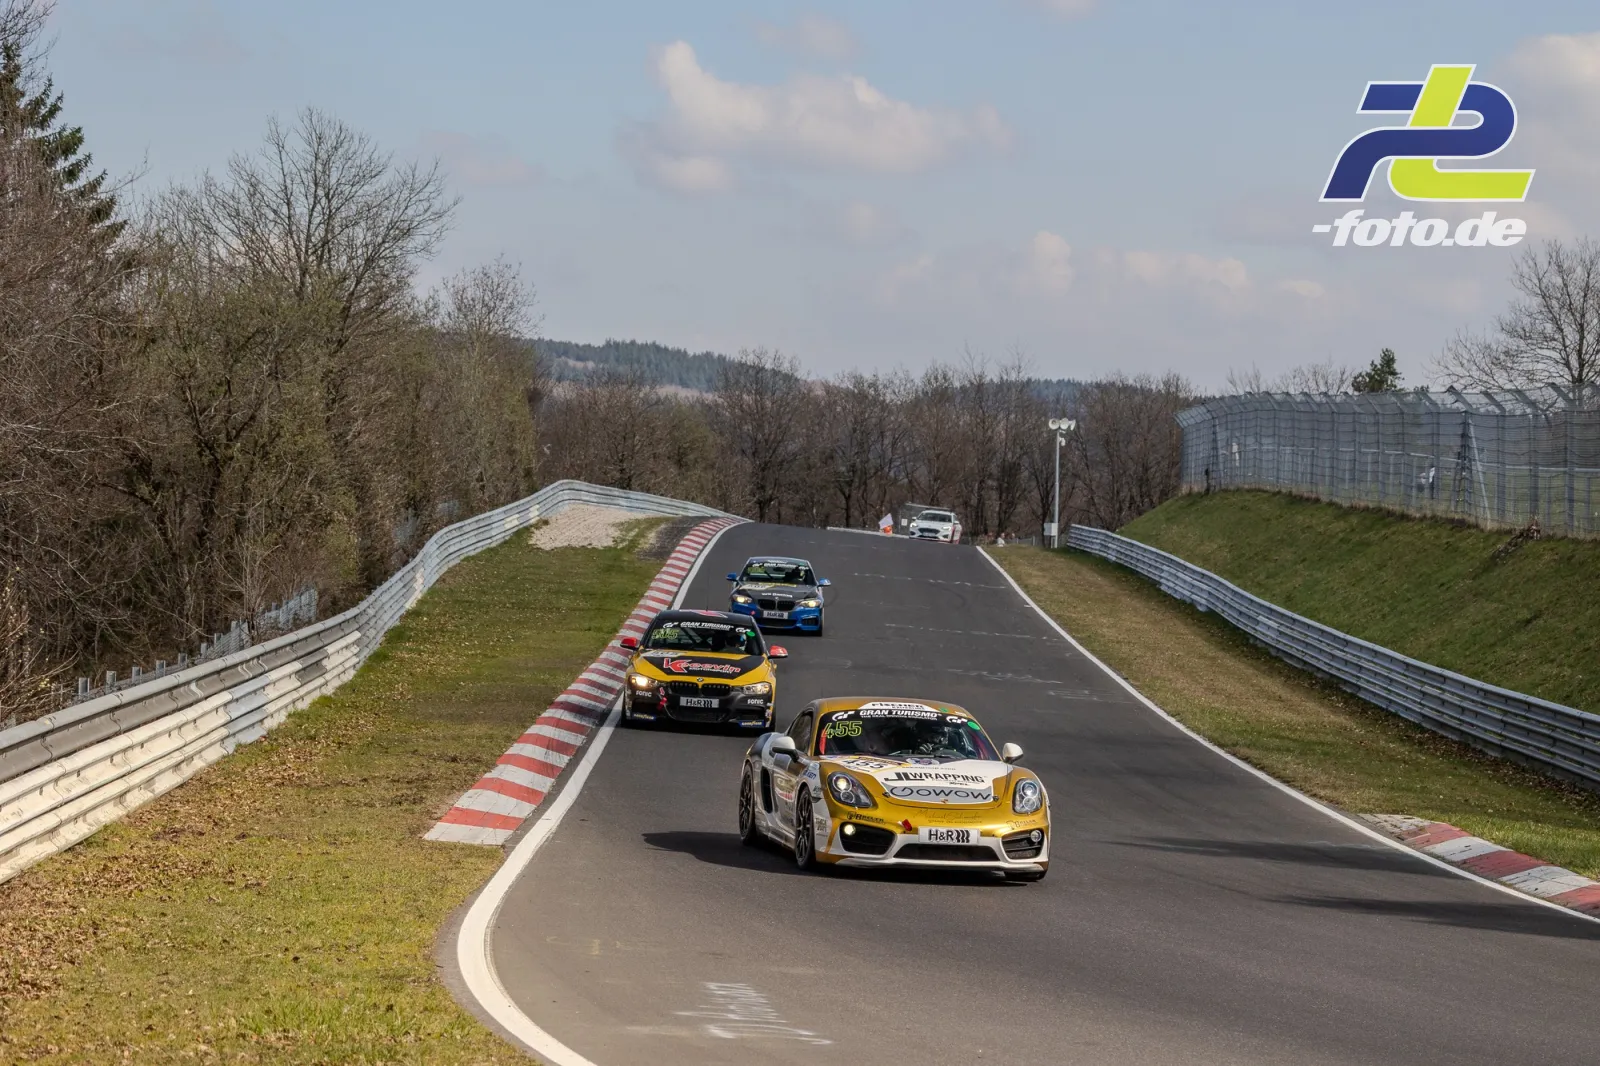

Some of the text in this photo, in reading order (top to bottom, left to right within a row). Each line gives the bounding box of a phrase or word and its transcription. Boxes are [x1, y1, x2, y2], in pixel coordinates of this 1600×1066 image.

[892, 710, 937, 718] TURISMO
[821, 721, 862, 738] 455
[929, 830, 954, 841] H&R
